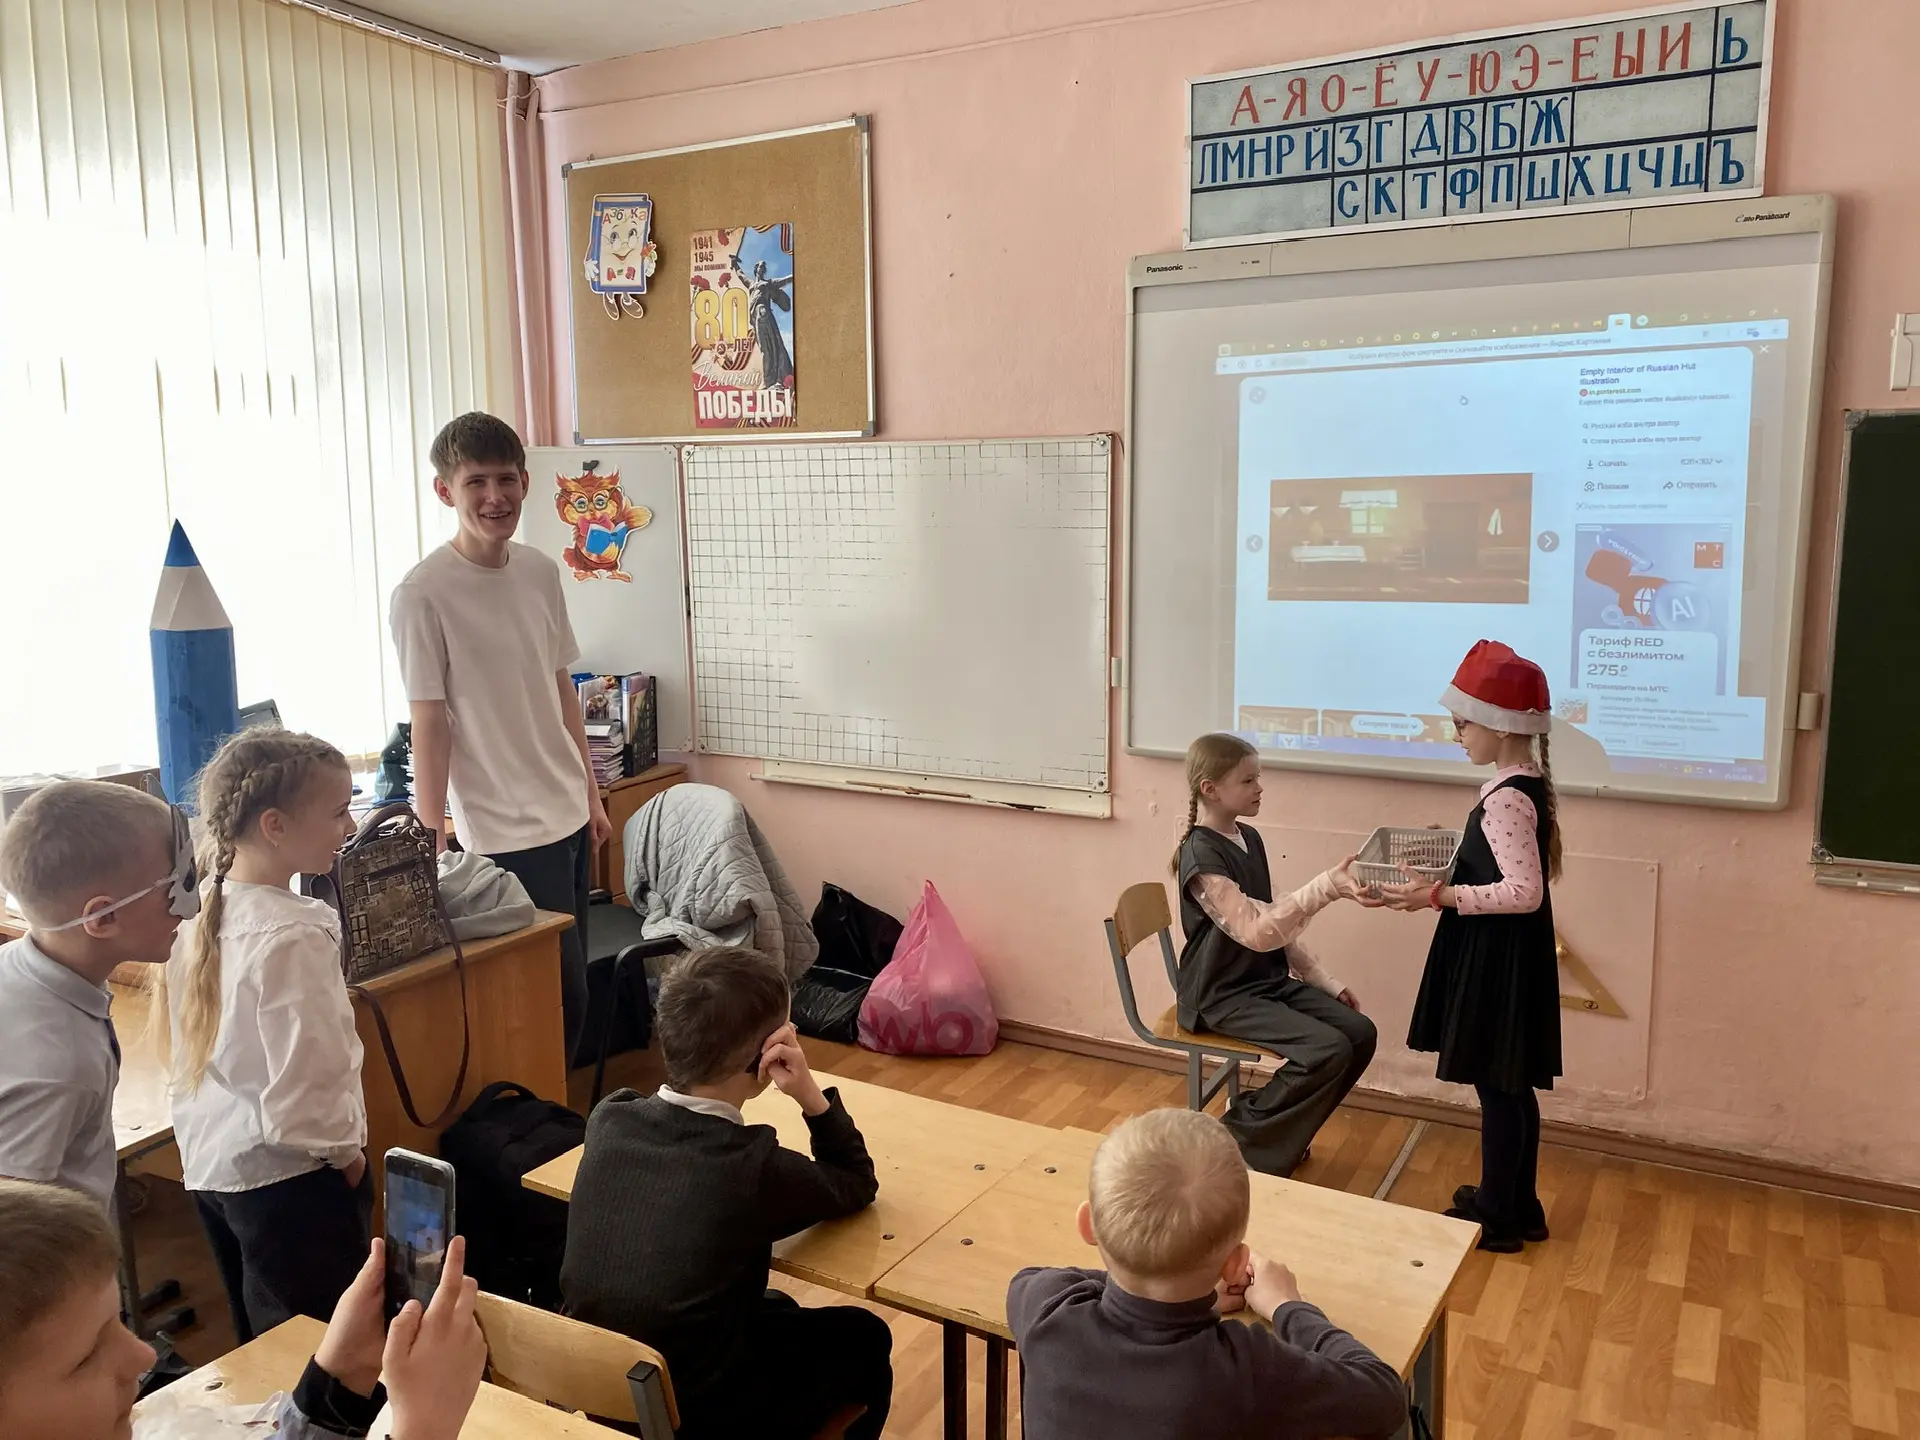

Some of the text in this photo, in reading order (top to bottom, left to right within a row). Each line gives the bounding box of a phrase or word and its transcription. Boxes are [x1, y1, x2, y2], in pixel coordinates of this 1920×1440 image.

[602, 207, 648, 225] Азбука
[1755, 211, 1791, 221] Panaboard
[693, 236, 713, 250] 1941
[694, 251, 714, 263] 1945
[1146, 263, 1184, 274] Panasonic
[694, 287, 749, 351] 80
[733, 338, 754, 353] ЛЕТ
[692, 360, 764, 391] Великой
[1580, 362, 1696, 377] Empty Interior of Russian Hut
[1580, 377, 1620, 386] Illustration
[697, 388, 792, 423] ПОБЕДЫ
[1671, 595, 1697, 622] AI
[1589, 635, 1664, 648] Тариф RED
[1587, 648, 1684, 661] с безлимитом
[1649, 685, 1669, 693] МТС
